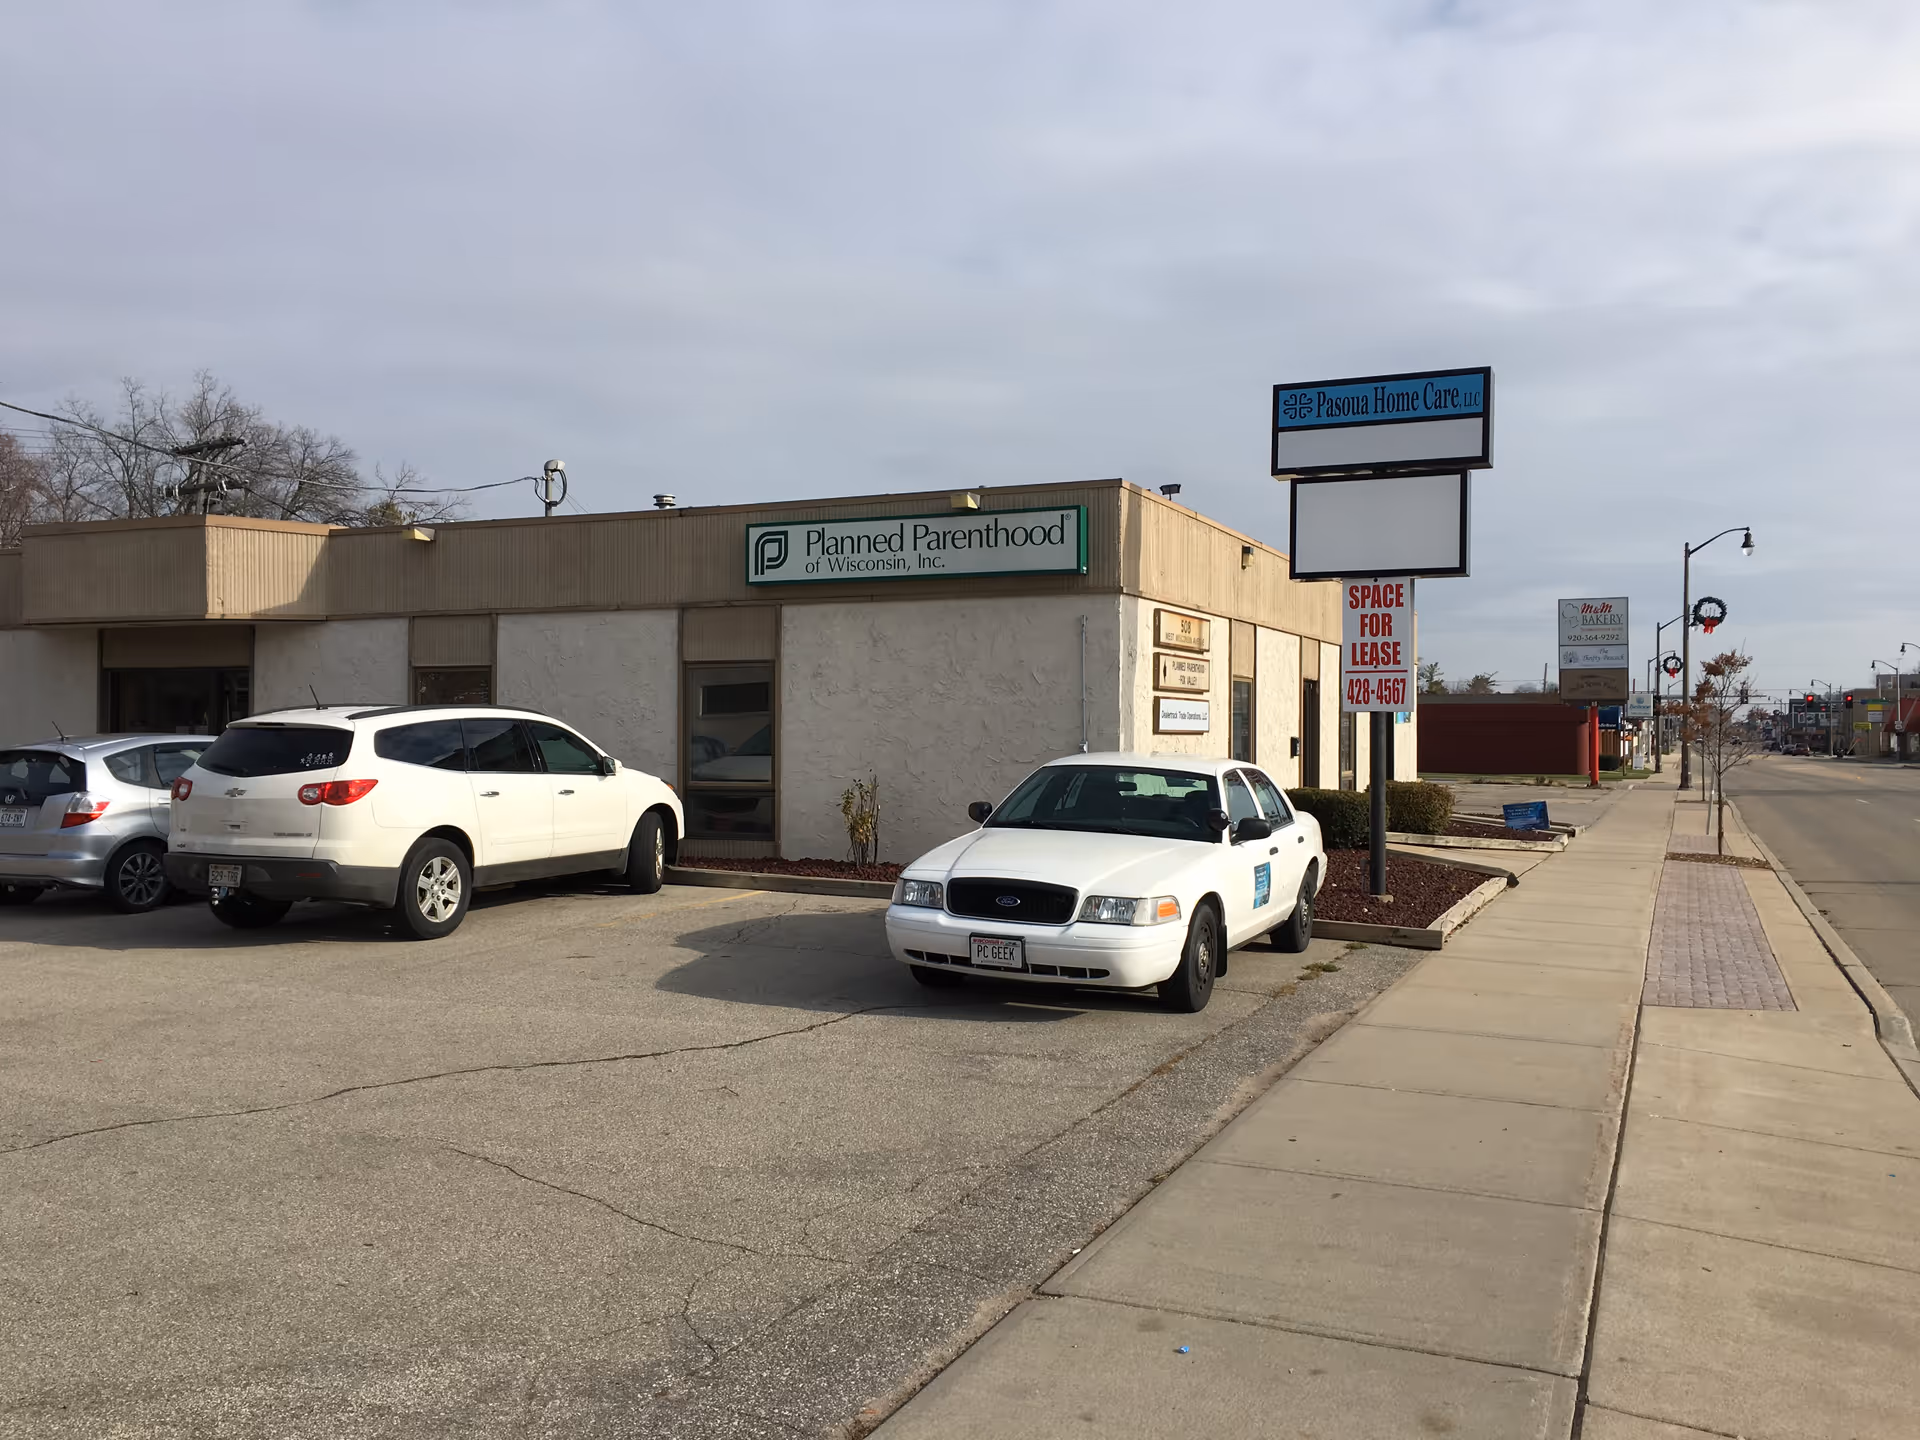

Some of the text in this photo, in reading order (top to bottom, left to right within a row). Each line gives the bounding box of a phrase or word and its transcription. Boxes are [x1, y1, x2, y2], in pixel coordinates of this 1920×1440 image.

[1373, 385, 1419, 414] Home
[1464, 391, 1480, 407] LLC
[806, 514, 1065, 557] Planned Parenthood
[805, 553, 945, 574] of Wisconsin, Inc.
[1348, 583, 1404, 610] SPACE
[1581, 602, 1613, 614] M&M
[1181, 619, 1192, 634] 508
[1360, 612, 1393, 638] FOR
[1582, 613, 1624, 625] BAKERY
[1567, 633, 1620, 642] 920-364-9292
[1351, 641, 1402, 666] LEASE
[1347, 677, 1407, 705] 428-4567
[977, 944, 1015, 961] PC GEEK
